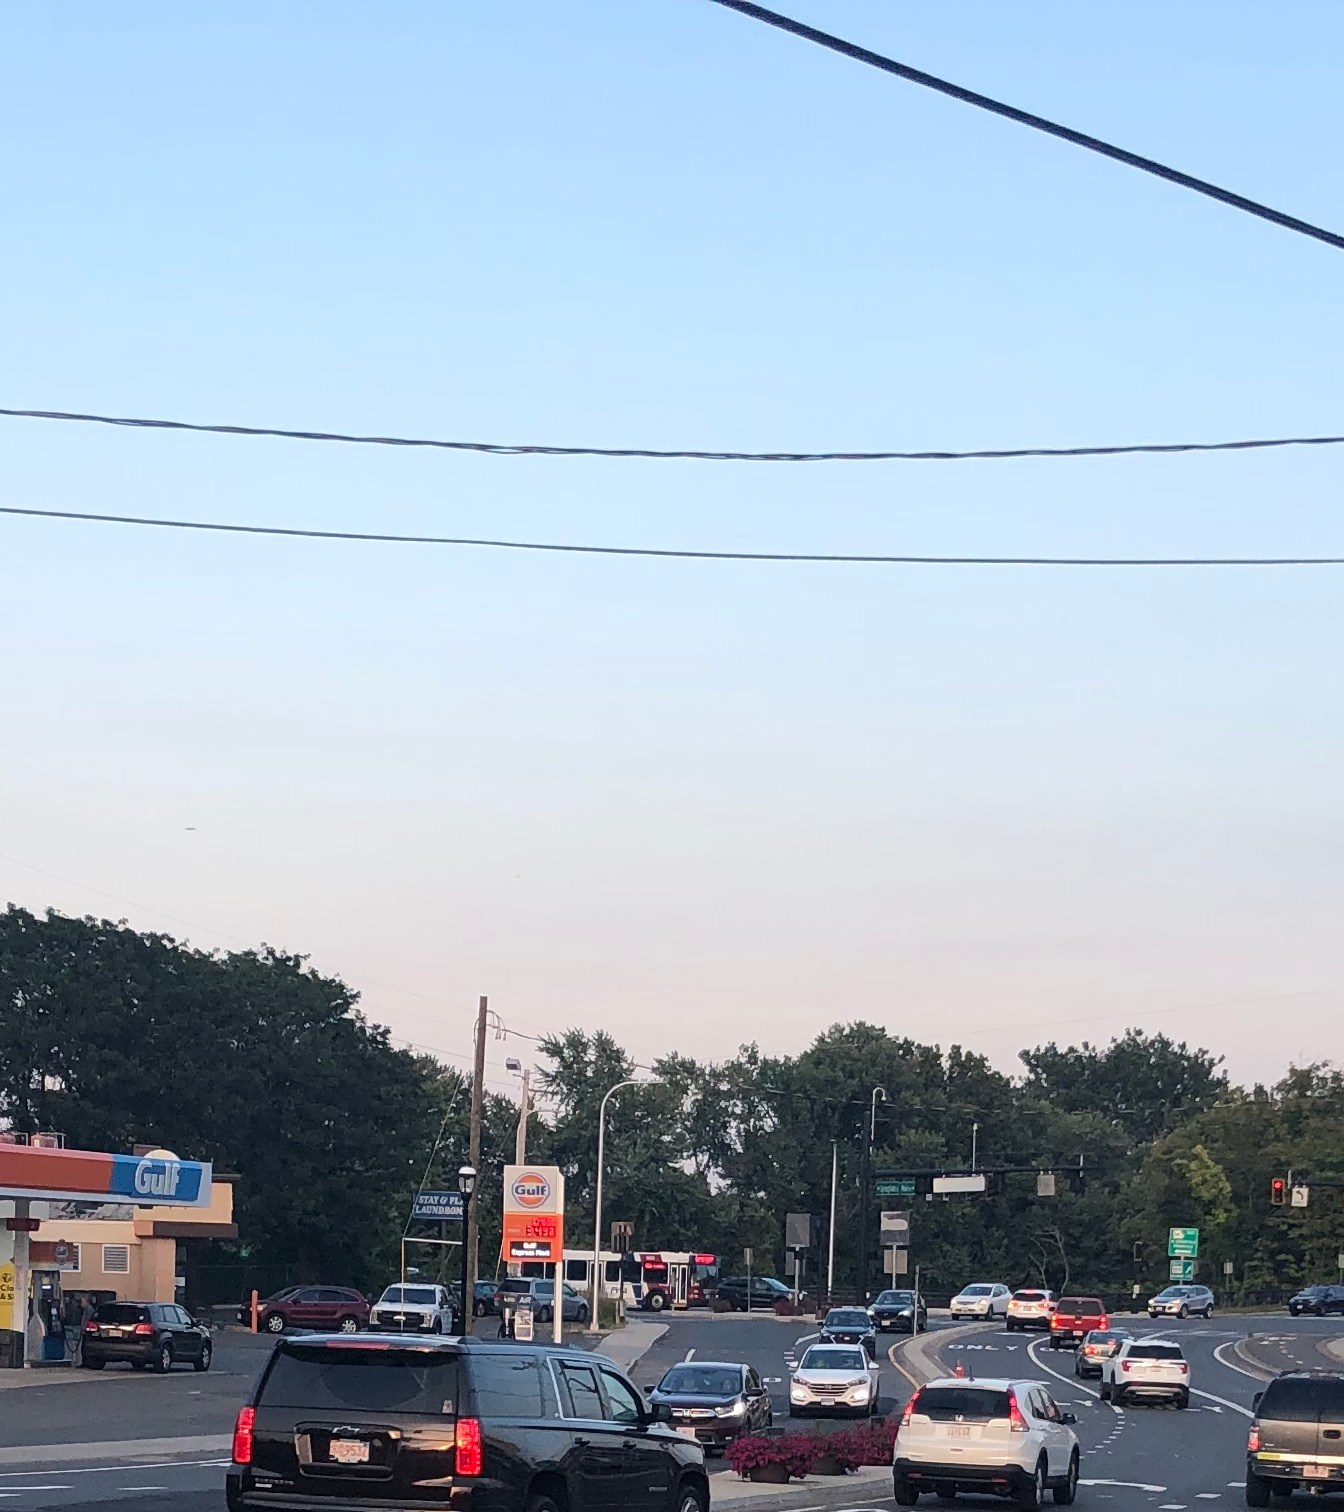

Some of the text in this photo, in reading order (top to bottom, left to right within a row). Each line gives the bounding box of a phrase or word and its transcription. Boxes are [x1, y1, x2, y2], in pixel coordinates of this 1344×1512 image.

[135, 1160, 180, 1195] Gulf
[515, 1184, 547, 1196] Gulf
[418, 1196, 439, 1205] STAY
[415, 1205, 463, 1215] LAUNDROM
